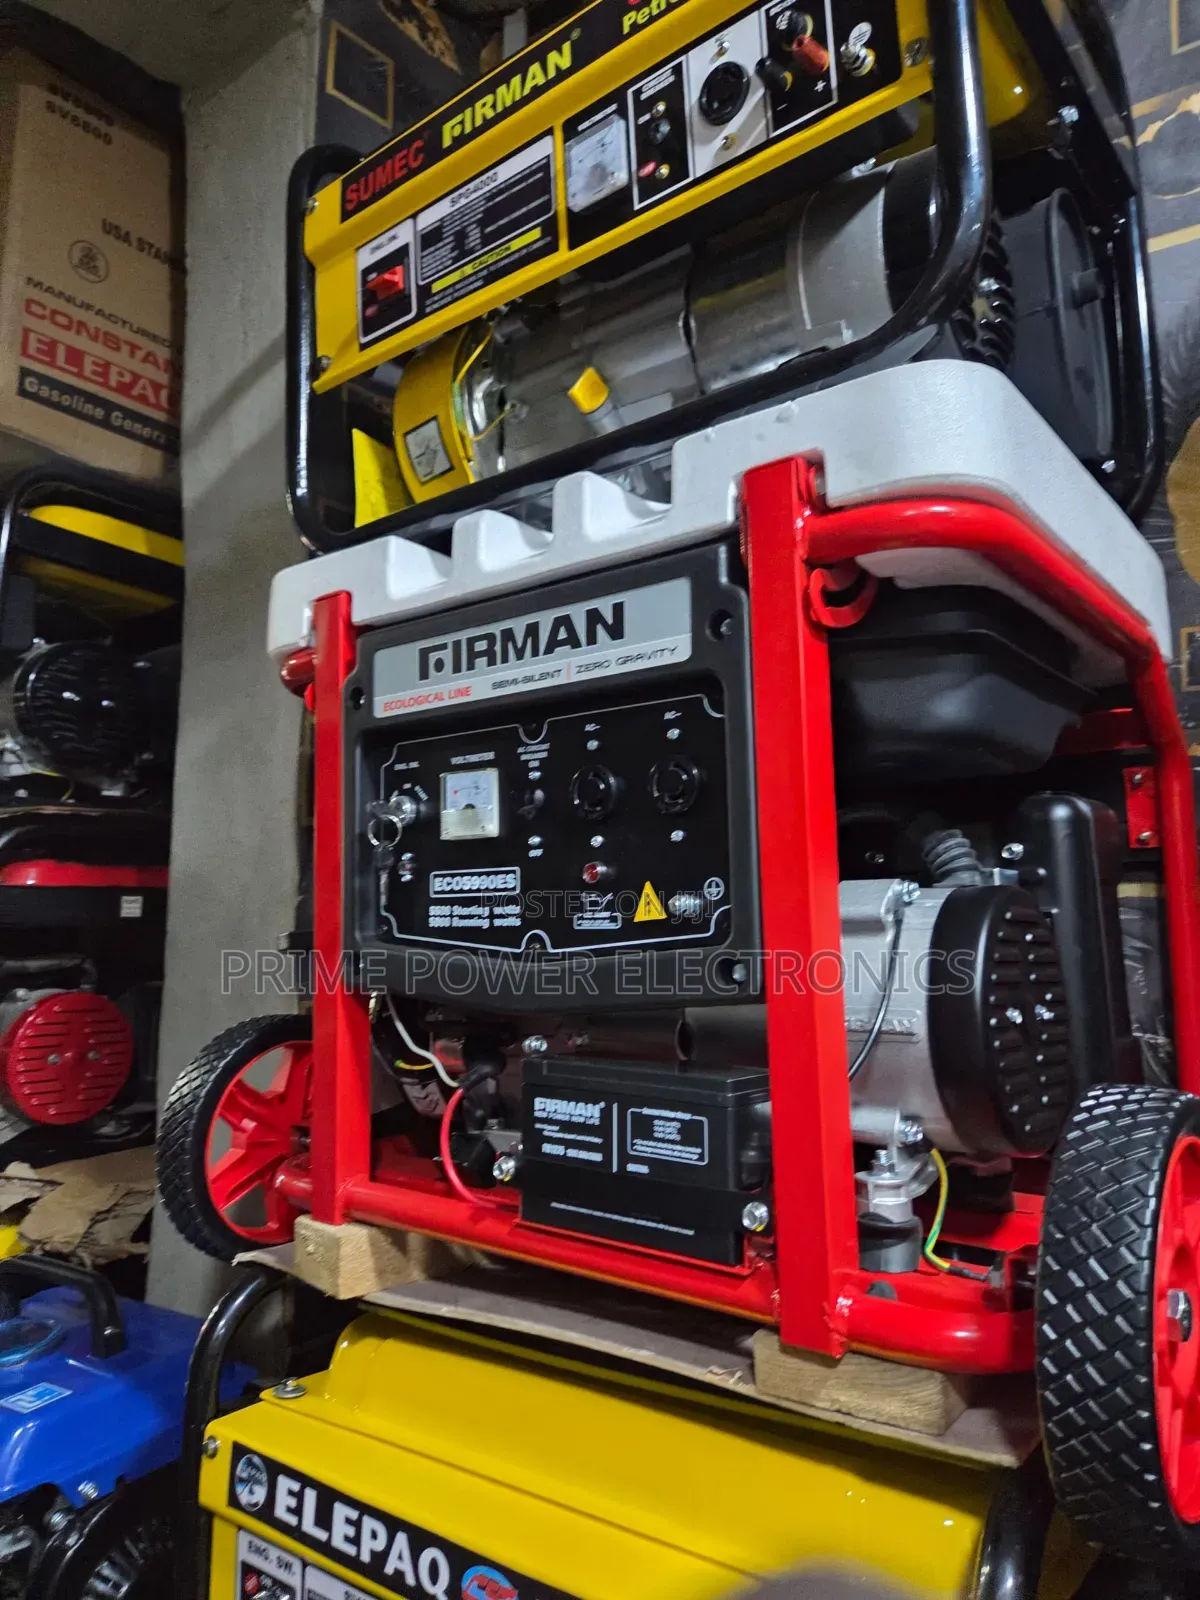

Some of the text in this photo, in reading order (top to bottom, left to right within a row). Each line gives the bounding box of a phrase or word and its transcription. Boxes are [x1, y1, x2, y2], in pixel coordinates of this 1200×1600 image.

[622, 0, 678, 35] Petr
[344, 139, 424, 211] SUMEC
[101, 218, 132, 247] USA
[471, 244, 511, 270] CAUTION
[25, 276, 173, 348] MANUFACTURED
[24, 376, 105, 420] Gasoline
[418, 600, 625, 682] FIRMAN
[491, 646, 679, 690] SEMI-SILENT ZERO GRAVITY
[383, 685, 472, 712] ECOLOGICAL LINE
[433, 873, 516, 891] ECO5990ES
[273, 1473, 450, 1600] ELEPAQ
